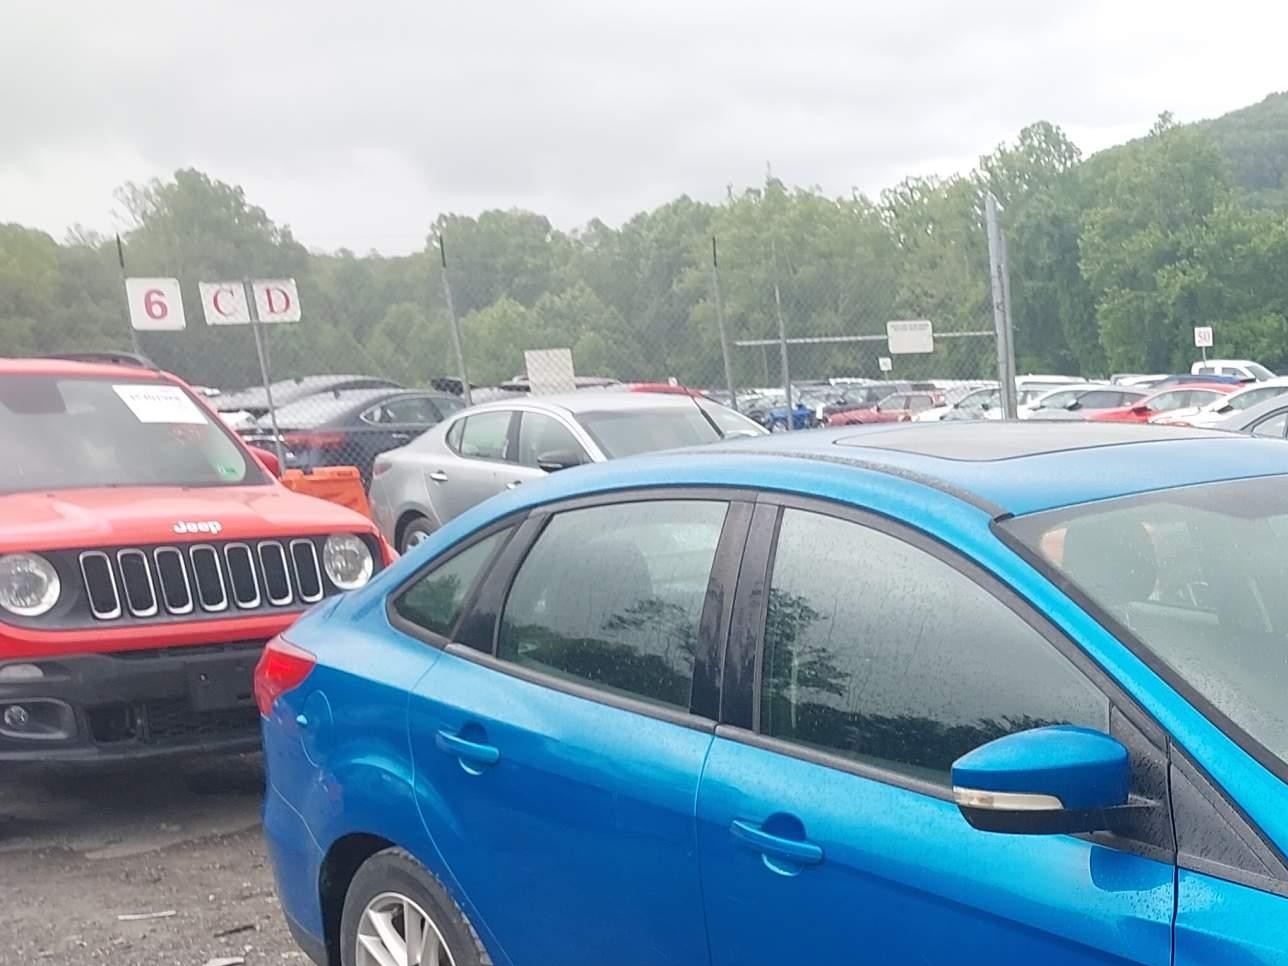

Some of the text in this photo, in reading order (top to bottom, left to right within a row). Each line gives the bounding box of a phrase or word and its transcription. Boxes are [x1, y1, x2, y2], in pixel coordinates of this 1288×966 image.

[144, 289, 168, 320] 6
[213, 288, 234, 316] C
[264, 287, 290, 314] D
[173, 520, 222, 534] Jeep
